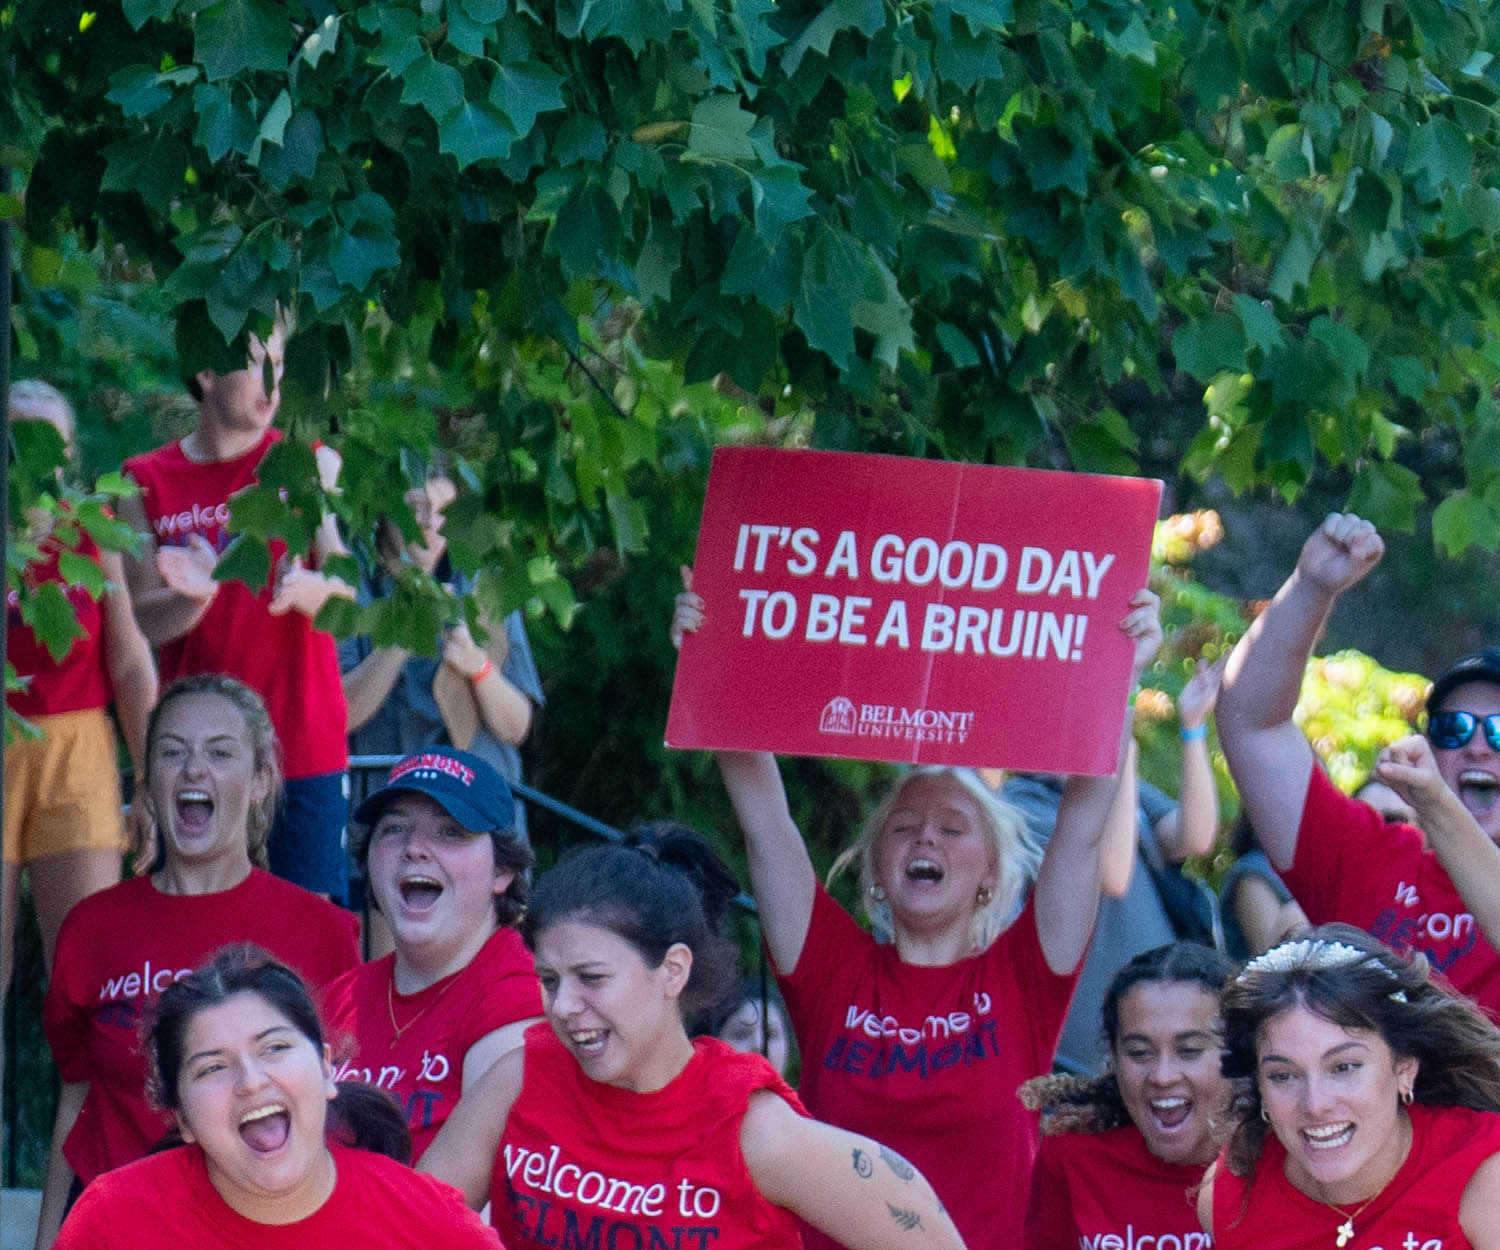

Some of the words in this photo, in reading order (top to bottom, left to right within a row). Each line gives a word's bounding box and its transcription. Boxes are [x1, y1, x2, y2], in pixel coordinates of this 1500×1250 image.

[733, 523, 821, 577] IT'S
[824, 530, 860, 579] A
[870, 532, 1009, 592] GOOD
[1016, 546, 1116, 599] DAY
[738, 587, 798, 640] TO
[804, 592, 873, 646] BE
[875, 598, 910, 649] A
[920, 605, 1089, 662] BRUIN!
[857, 723, 969, 744] UNIVERSITY
[859, 704, 972, 730] BELMONT
[676, 1177, 721, 1219] to
